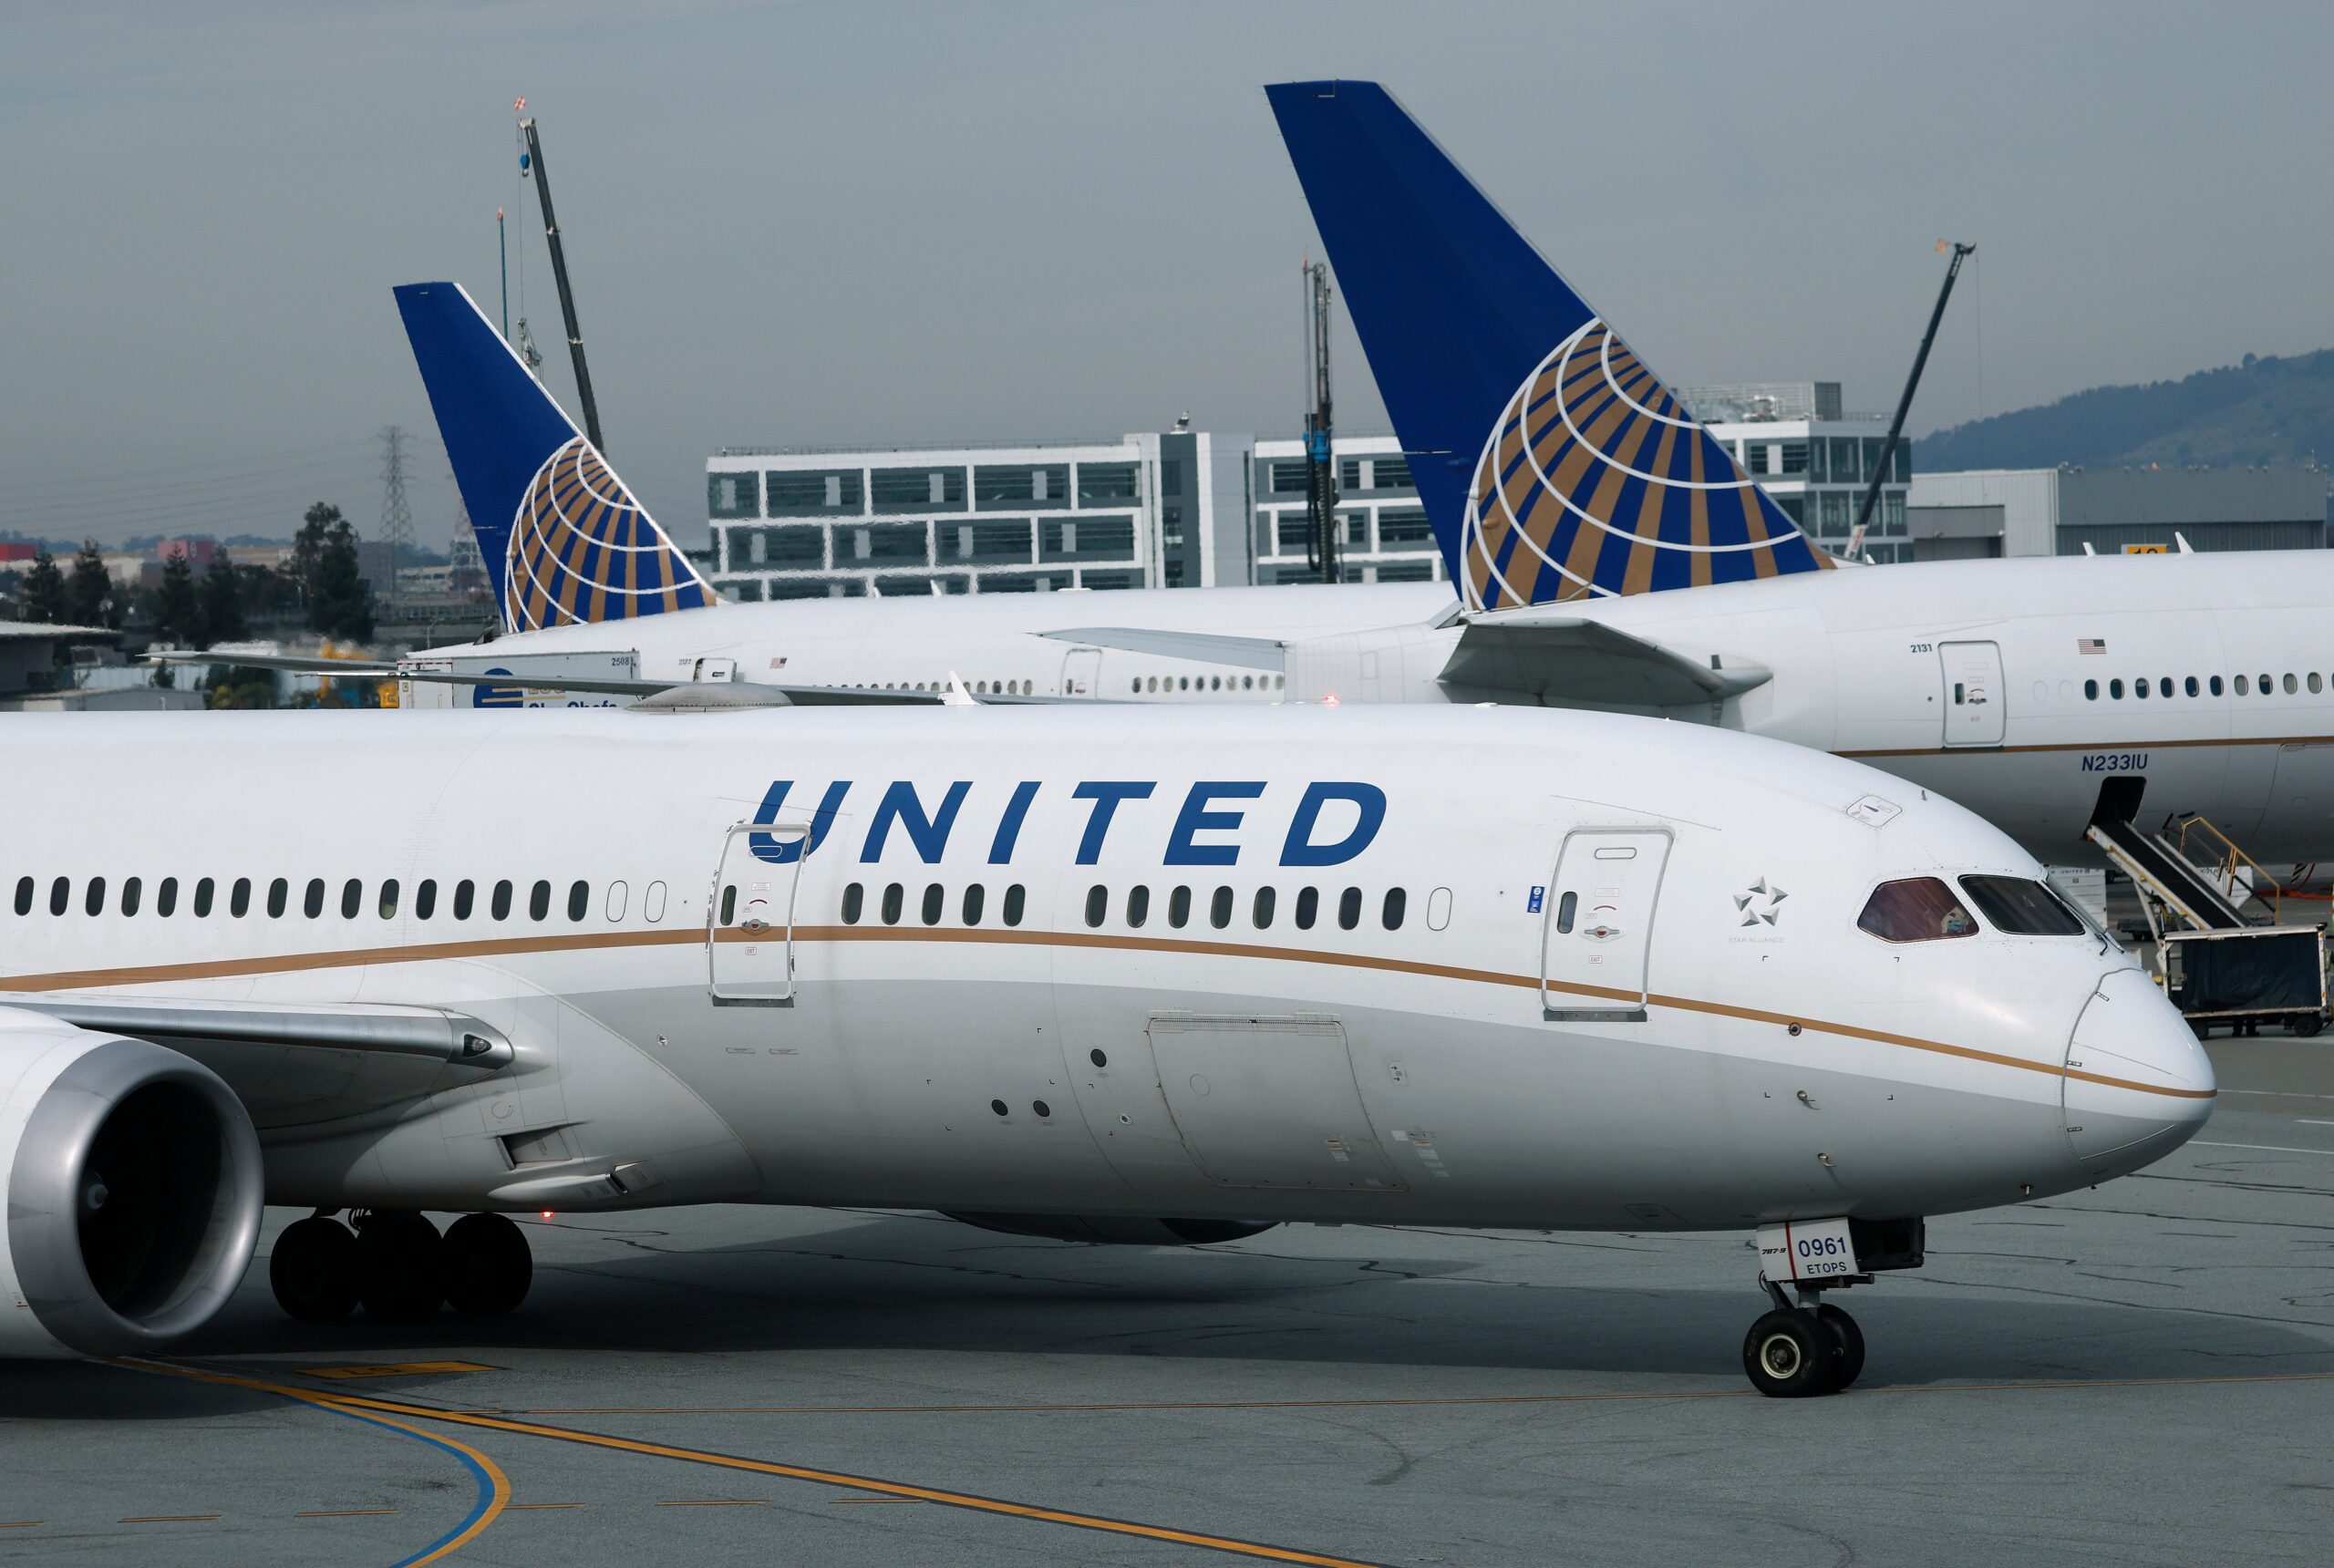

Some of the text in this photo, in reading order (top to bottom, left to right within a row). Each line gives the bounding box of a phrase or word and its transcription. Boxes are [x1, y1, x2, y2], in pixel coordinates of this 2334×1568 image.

[1910, 644, 1932, 653] 2131
[612, 657, 629, 666] 2508
[749, 780, 1387, 866] UNITED
[1761, 1247, 1787, 1255] 787-9
[1798, 1236, 1847, 1258] 0961
[1806, 1261, 1847, 1274] ETOPS
